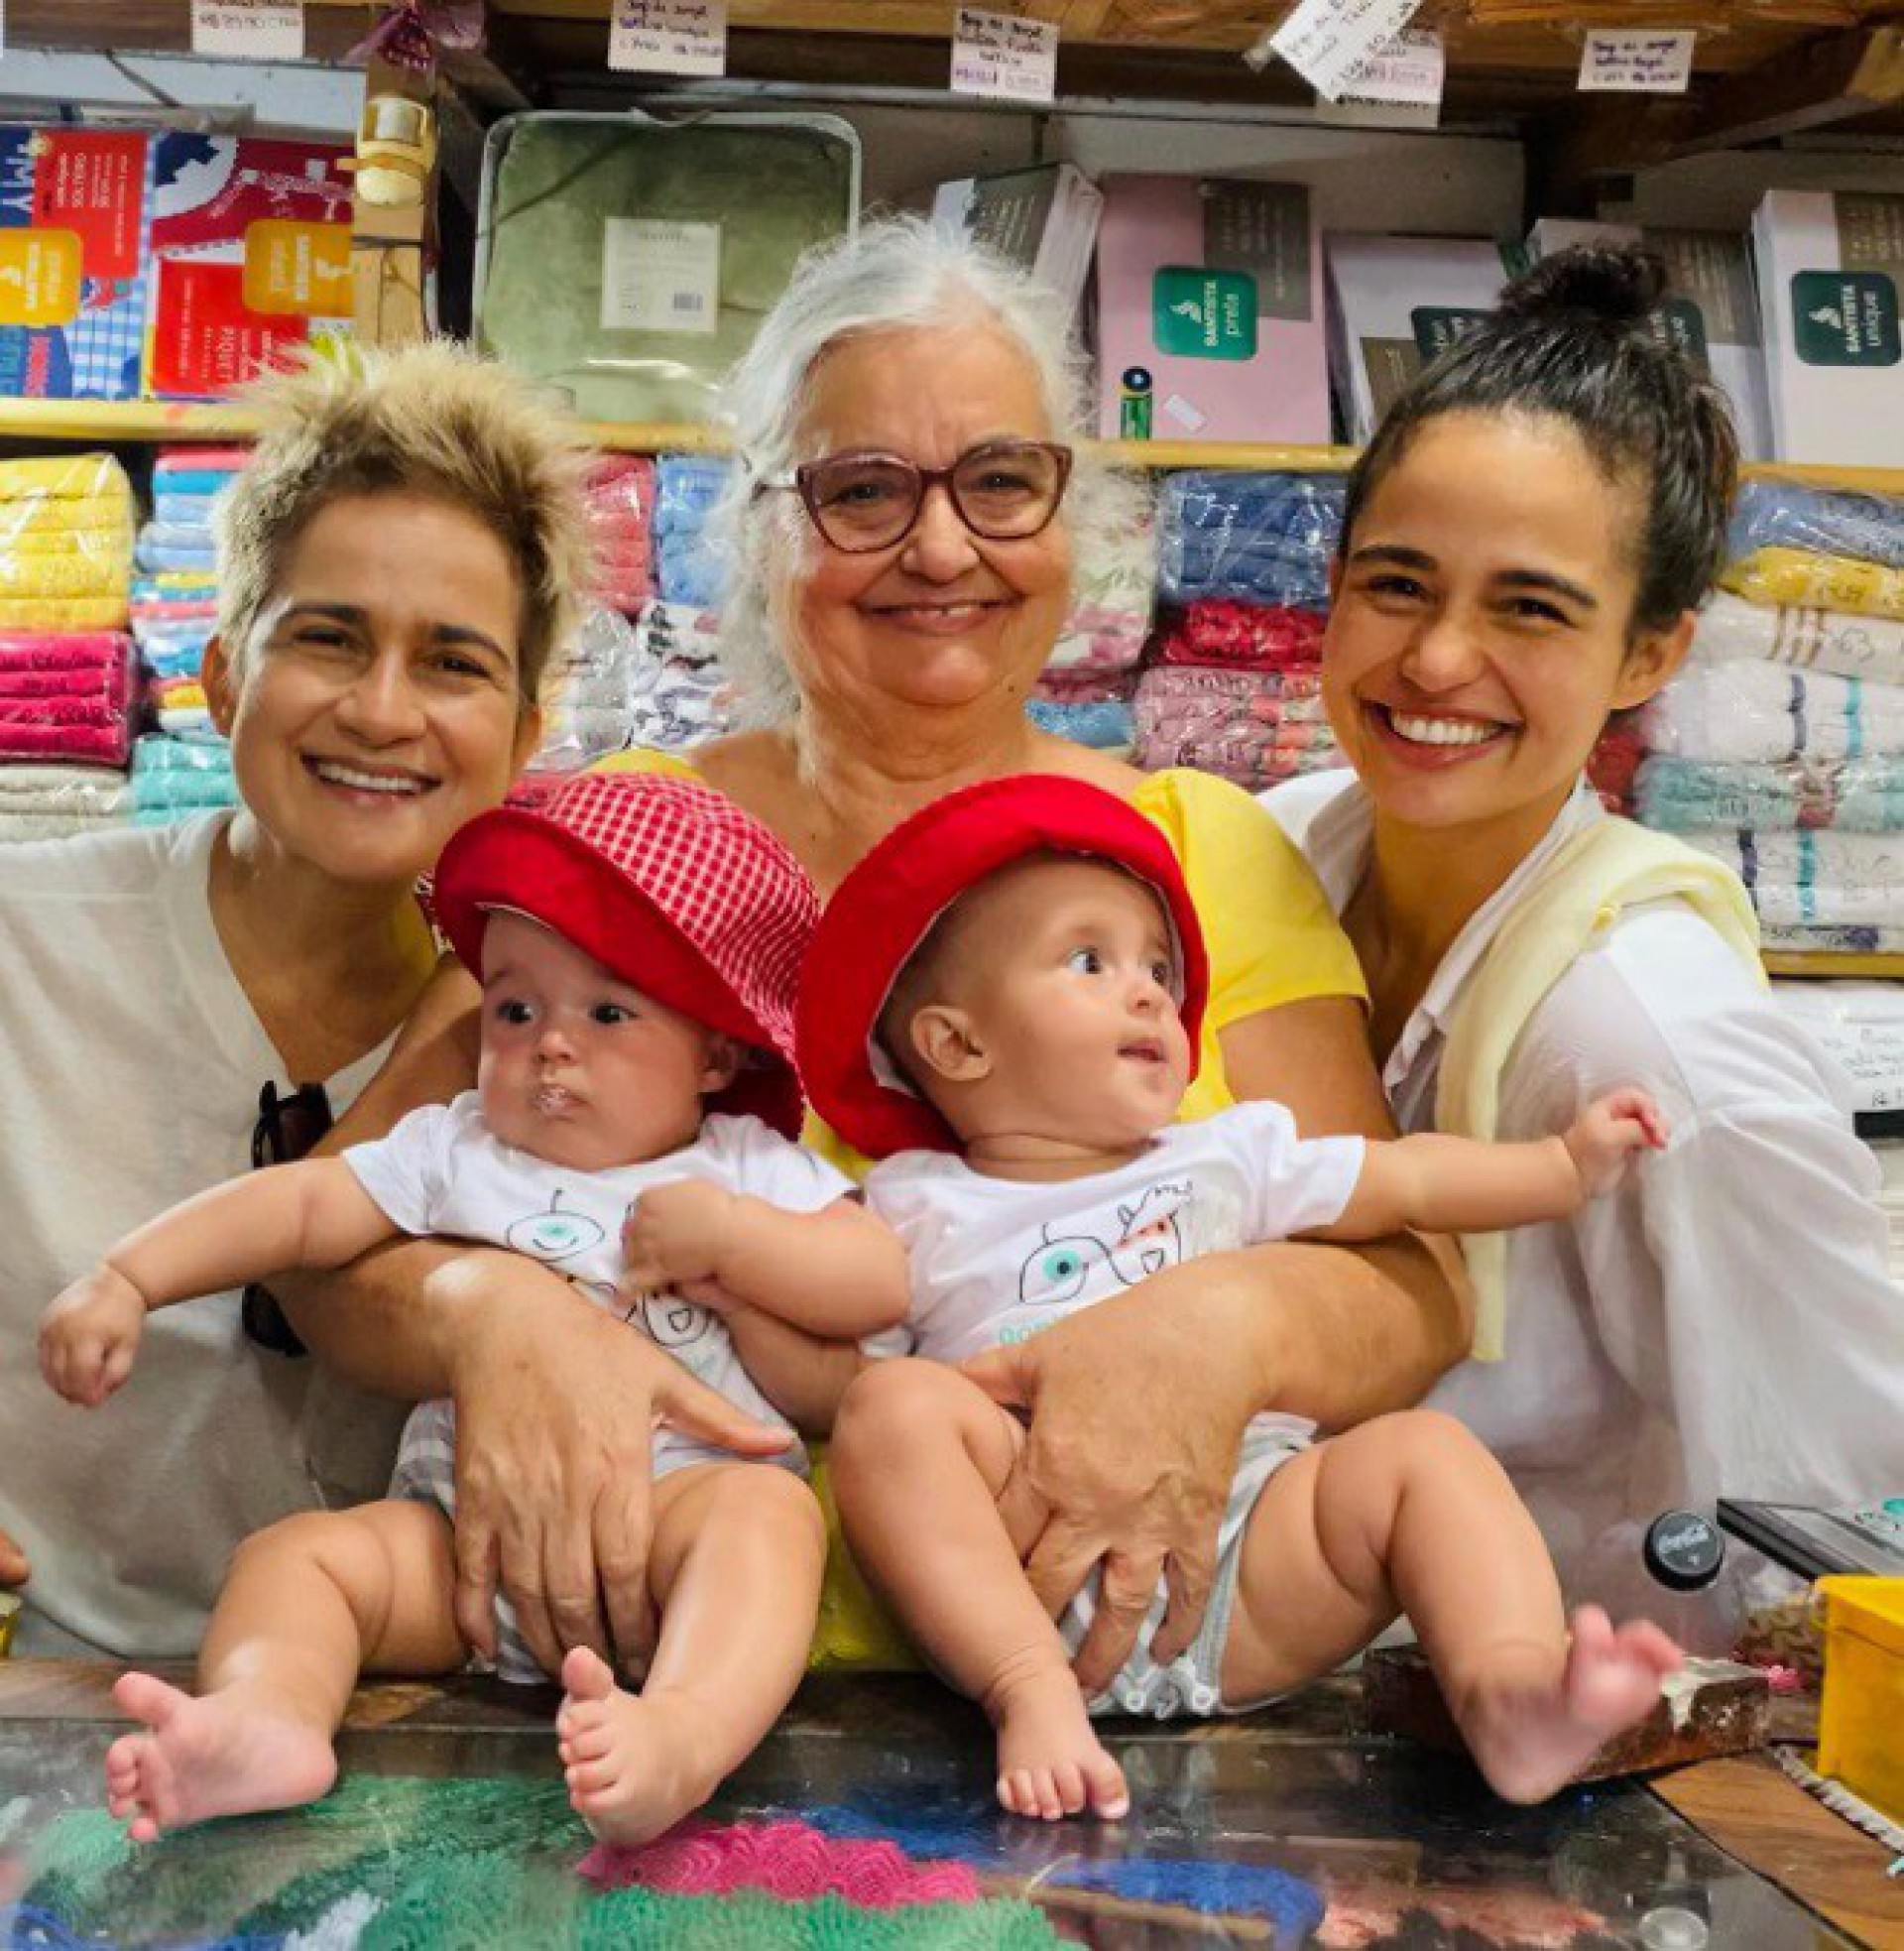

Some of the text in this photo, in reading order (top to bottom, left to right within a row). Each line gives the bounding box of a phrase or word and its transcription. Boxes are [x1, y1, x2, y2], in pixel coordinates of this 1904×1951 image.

[1203, 280, 1219, 347] SANTISTA
[1841, 285, 1861, 353] SANTISTA
[1862, 291, 1883, 347] unique
